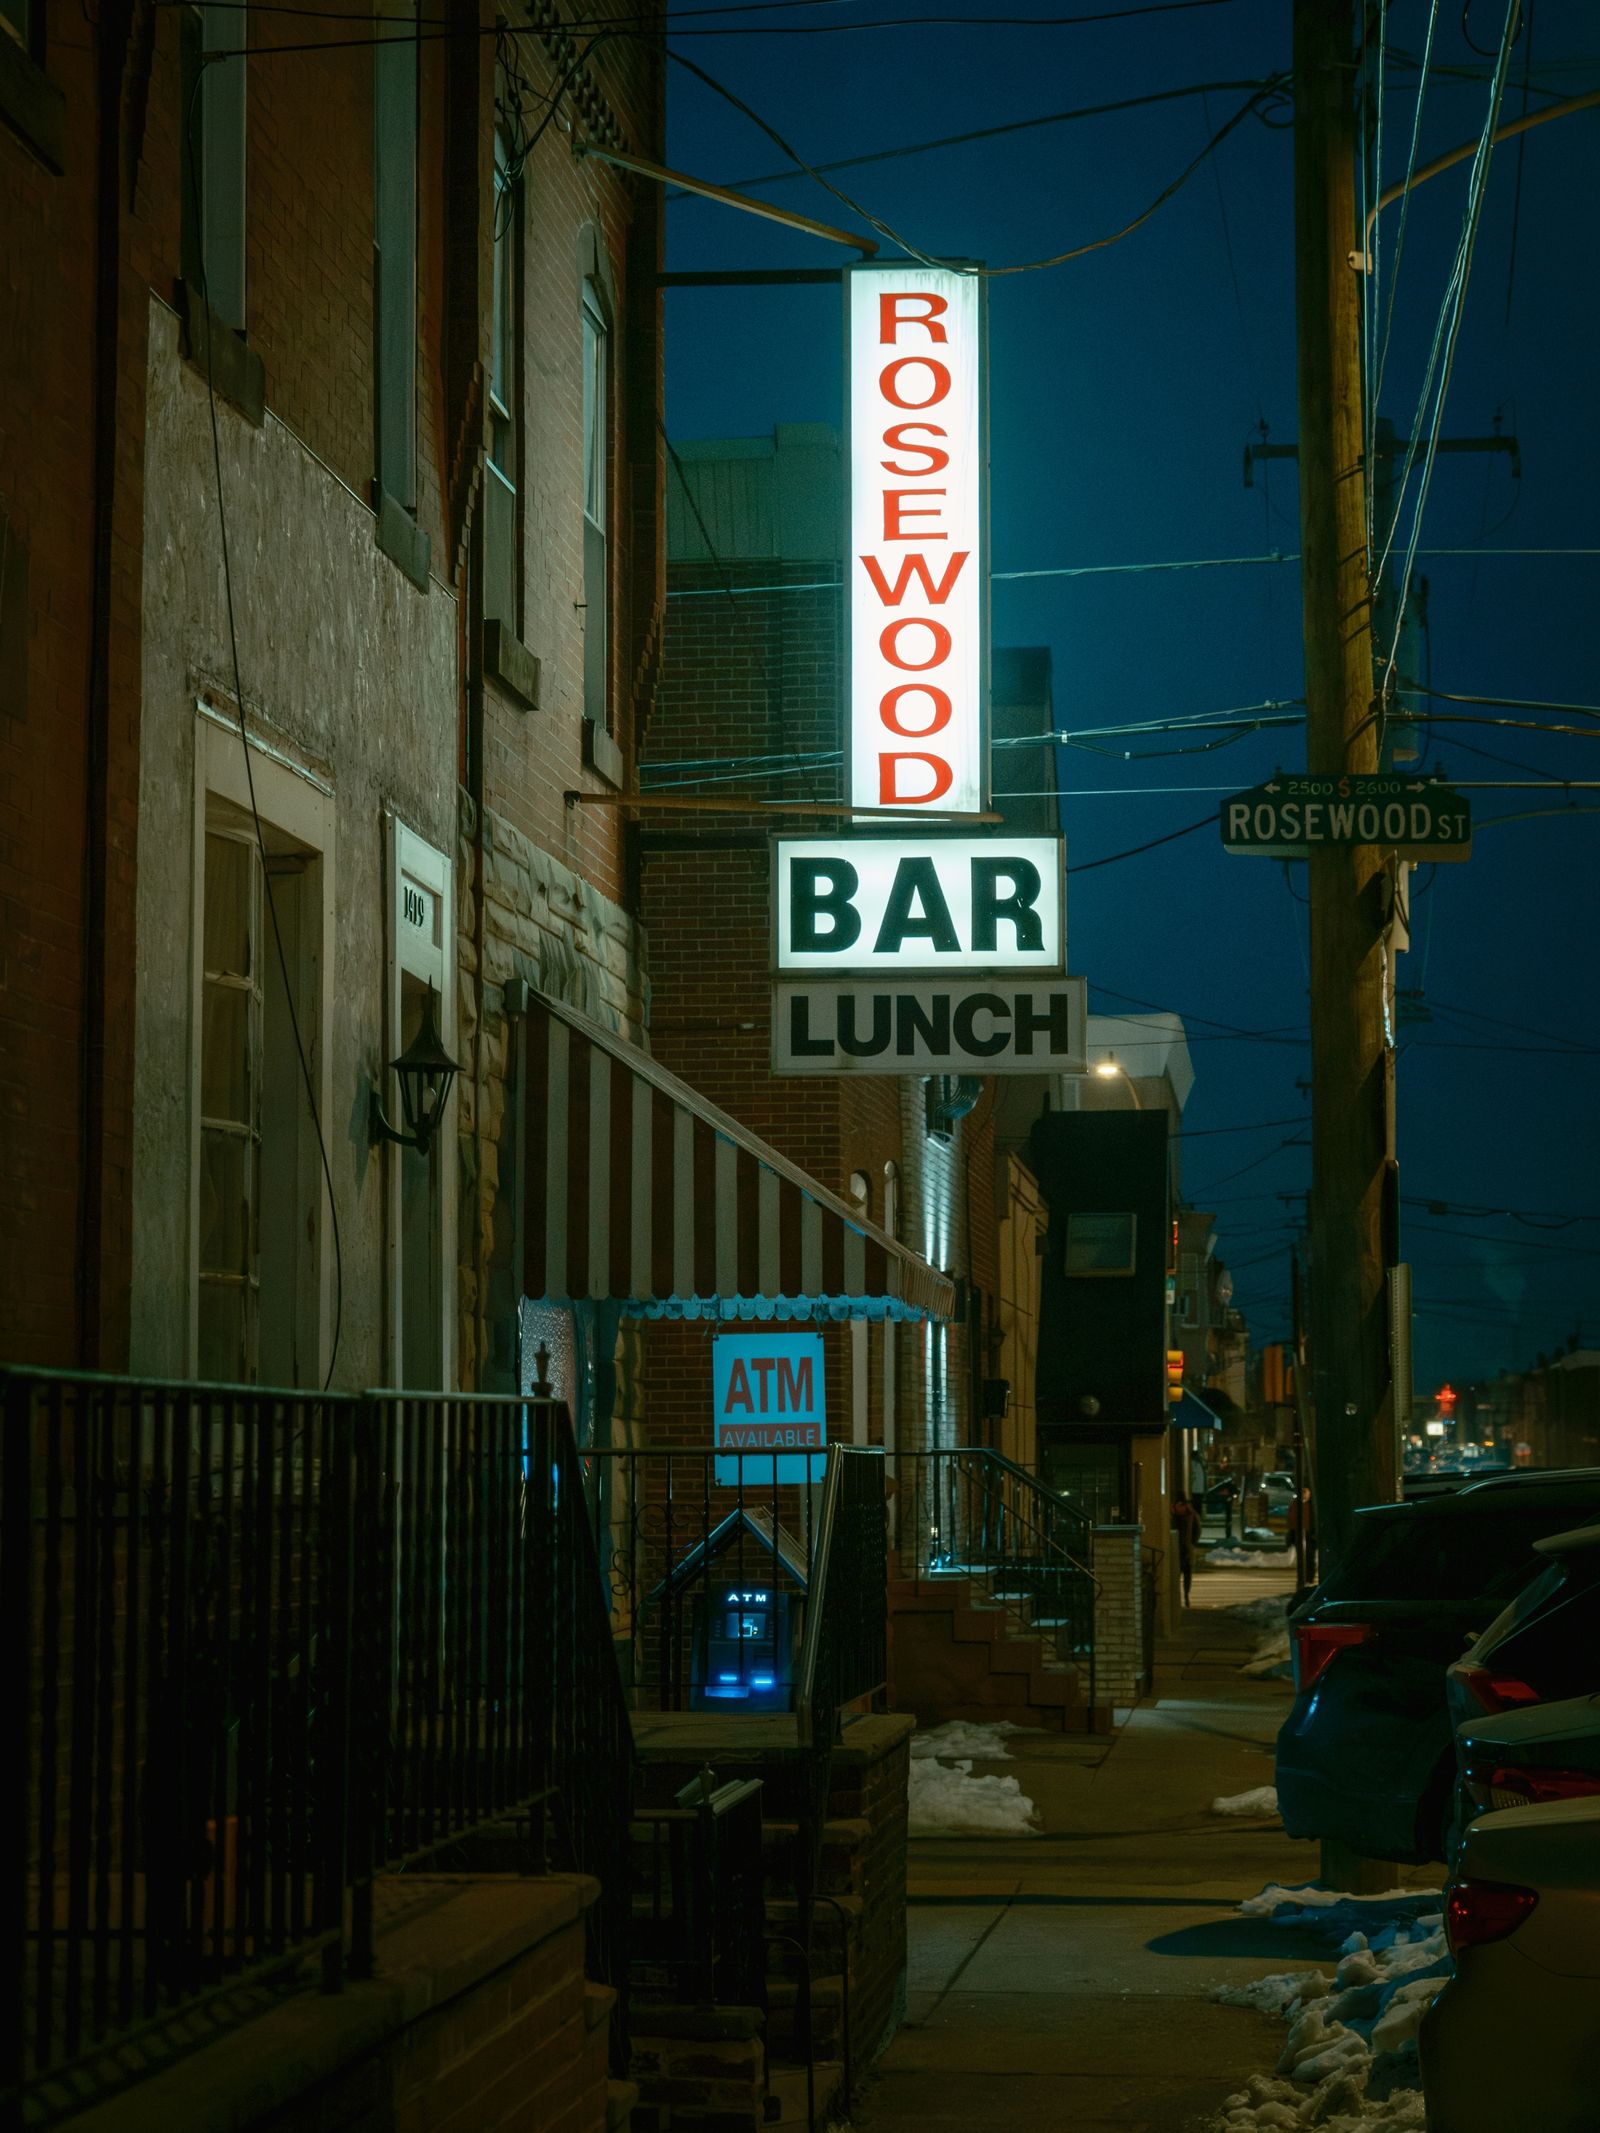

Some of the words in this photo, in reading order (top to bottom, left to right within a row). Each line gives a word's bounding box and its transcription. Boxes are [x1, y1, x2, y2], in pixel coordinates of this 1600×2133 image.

[858, 291, 970, 806] ROSEWOOD
[1287, 780, 1334, 796] 2500
[1338, 777, 1350, 799] S
[1355, 780, 1400, 795] 2600
[1229, 803, 1432, 840] ROSEWOOD
[1437, 814, 1467, 839] ST
[789, 856, 1046, 953] BAR
[790, 992, 1069, 1057] LUNCH
[724, 1357, 813, 1414] ATM
[723, 1428, 816, 1448] AVAILABLE
[727, 1593, 767, 1602] ATM
